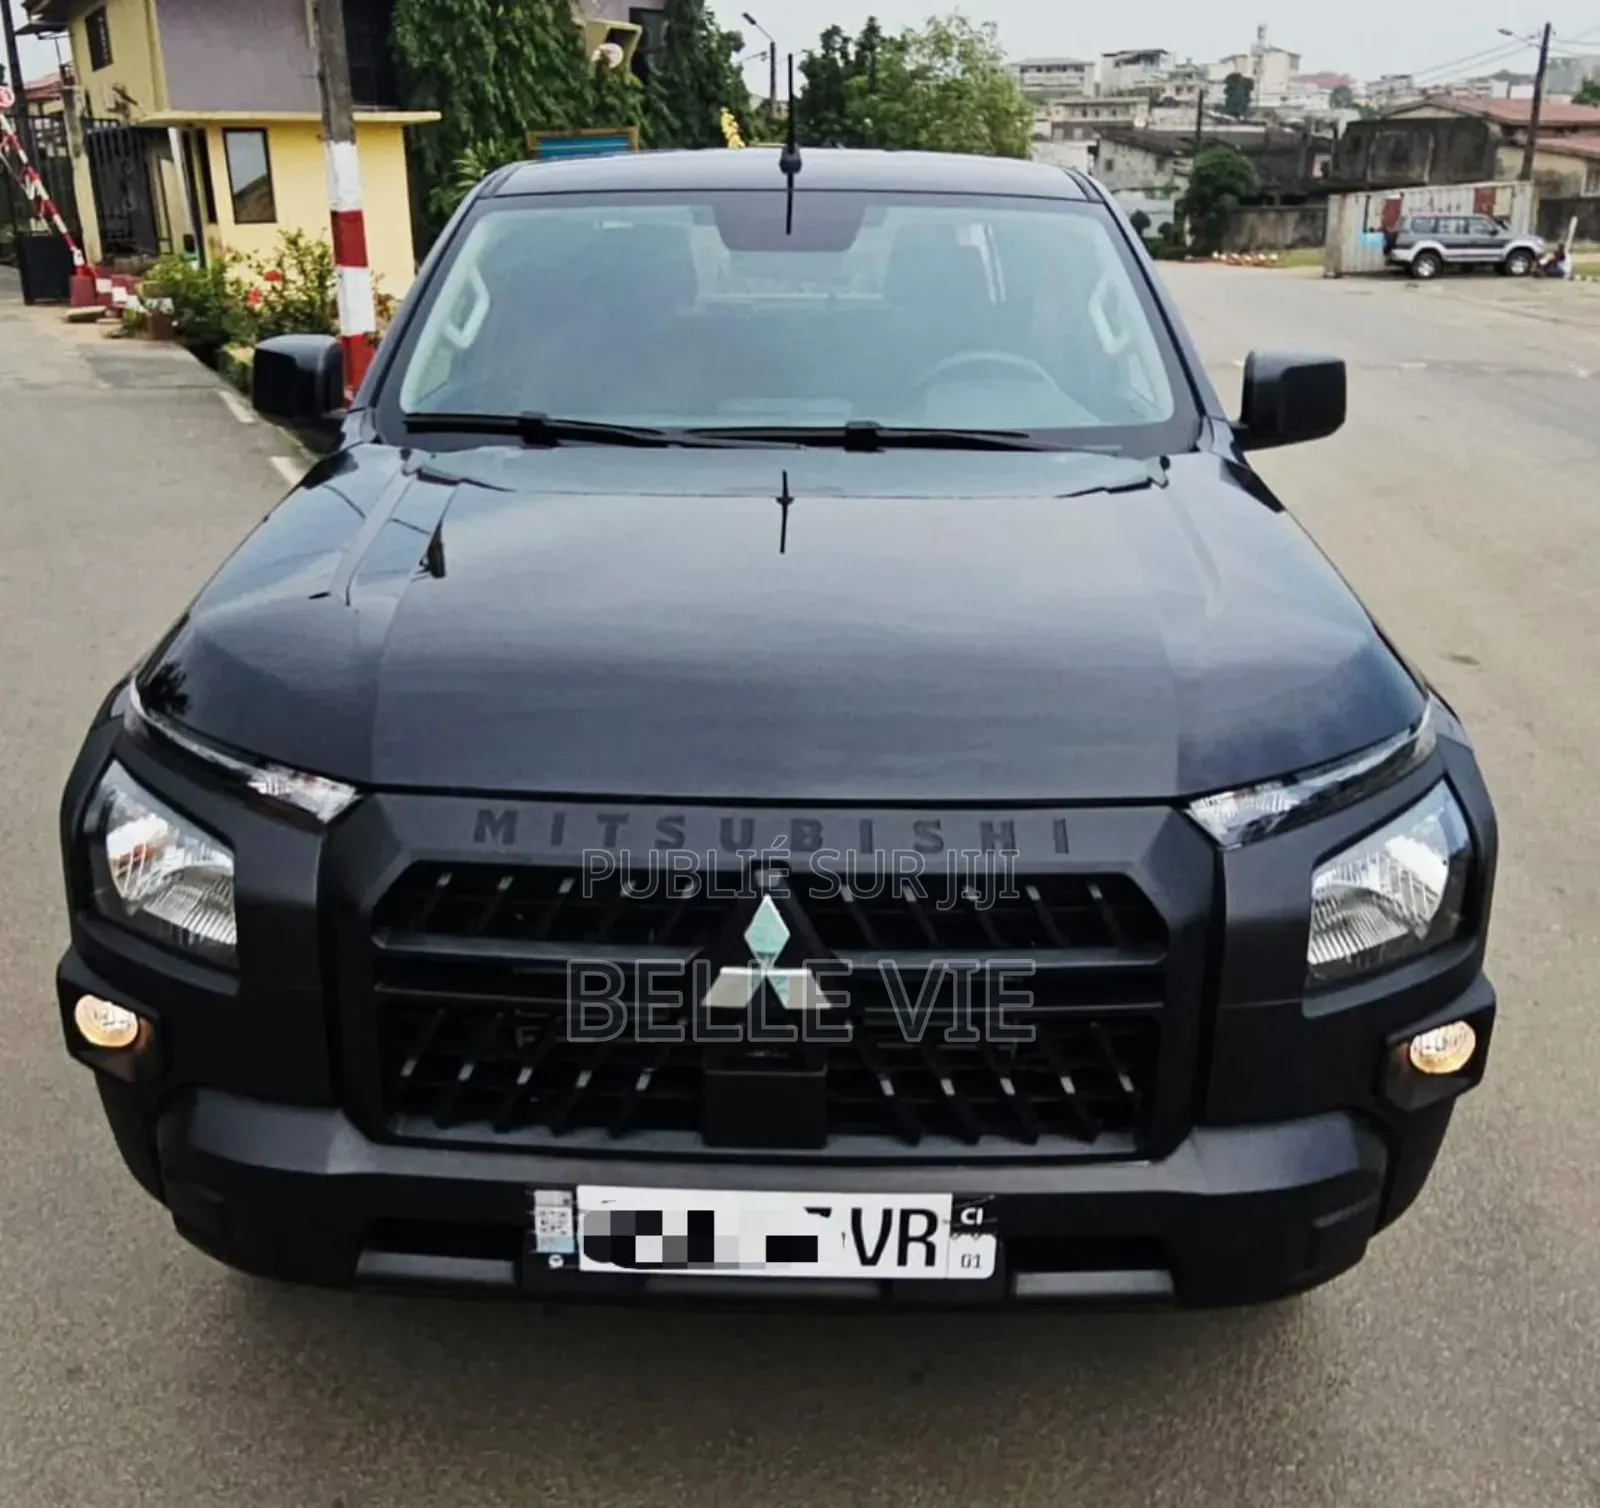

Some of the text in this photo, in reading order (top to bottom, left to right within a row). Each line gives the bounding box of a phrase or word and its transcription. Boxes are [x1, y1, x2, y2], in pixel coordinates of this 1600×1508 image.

[473, 808, 1070, 856] MITSUBISHI
[961, 1207, 983, 1226] CI
[851, 1207, 938, 1267] VR
[960, 1253, 981, 1269] 01
